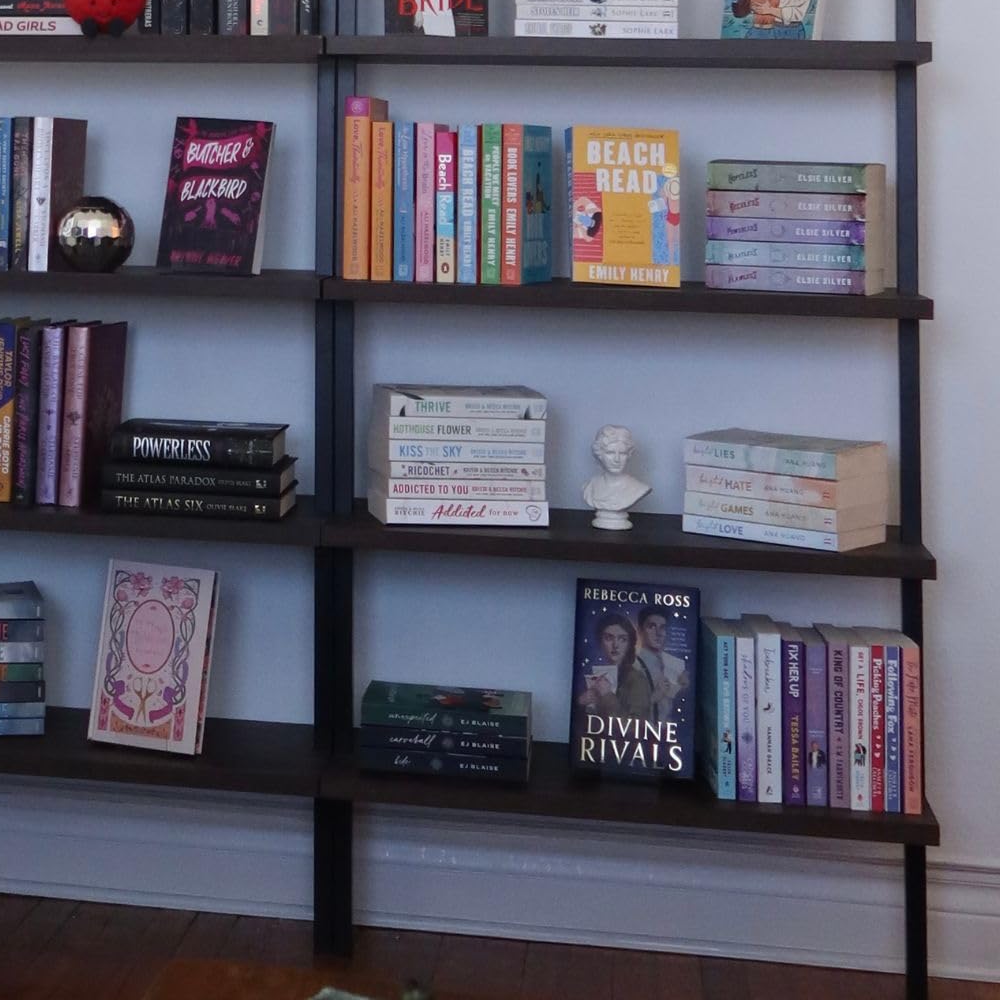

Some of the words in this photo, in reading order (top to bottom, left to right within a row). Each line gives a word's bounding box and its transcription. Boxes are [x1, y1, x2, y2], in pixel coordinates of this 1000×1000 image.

[16, 20, 57, 32] GIRLS
[186, 142, 242, 166] BUTCHER
[506, 147, 518, 170] BOOK
[587, 140, 665, 166] BEACH
[438, 154, 453, 190] Beach
[462, 149, 474, 185] BEACH
[180, 178, 248, 202] BLACKBIRD
[506, 172, 517, 203] LOVERS
[596, 168, 658, 194] READ
[824, 175, 853, 184] SILVER
[438, 194, 452, 224] Read
[462, 188, 474, 217] READ
[487, 208, 496, 235] EMILY
[506, 207, 517, 235] EMILY
[795, 228, 820, 237] ELSIE
[821, 229, 850, 238] SILVER
[487, 237, 496, 266] HENRY
[505, 237, 516, 266] HENRY
[823, 254, 851, 263] SILVER
[589, 264, 626, 281] EMILY
[629, 266, 670, 283] HENRY
[796, 276, 820, 285] ELSIE
[4, 351, 13, 387] TAYLOR
[415, 401, 452, 413] THRIVE
[2, 416, 11, 449] CARRIE
[437, 424, 472, 436] FLOWER
[133, 436, 211, 461] POWERLESS
[399, 445, 423, 457] KISS
[442, 445, 463, 458] SKY
[714, 448, 736, 460] LIES
[2, 450, 10, 474] SOTO
[408, 465, 450, 476] RICOCHET
[115, 472, 134, 483] THE
[138, 473, 167, 484] ATLAS
[170, 475, 216, 486] PARADOX
[392, 483, 435, 495] ADDICTED
[438, 484, 449, 494] TO
[451, 484, 469, 495] YOU
[724, 479, 752, 492] HATE
[115, 495, 139, 508] THE
[144, 497, 180, 510] ATLAS
[184, 499, 204, 511] SIX
[431, 503, 488, 520] Addicted
[720, 503, 755, 516] GAMES
[719, 523, 744, 536] LOVE
[583, 587, 649, 604] REBECCA
[654, 593, 691, 608] ROSS
[789, 644, 799, 661] FIX
[833, 650, 844, 672] KING
[789, 662, 799, 682] HER
[834, 675, 844, 686] OF
[870, 658, 883, 694] Picking
[789, 683, 799, 698] UP
[885, 659, 899, 713] Following
[833, 690, 844, 734] COUNTRY
[871, 694, 881, 731] Peaches
[472, 720, 500, 728] BLAISE
[587, 714, 679, 744] DIVINE
[791, 714, 799, 744] TESSA
[887, 714, 898, 734] Fox
[472, 742, 500, 750] BLAISE
[580, 736, 683, 773] RIVALS
[471, 764, 499, 772] BLAISE
